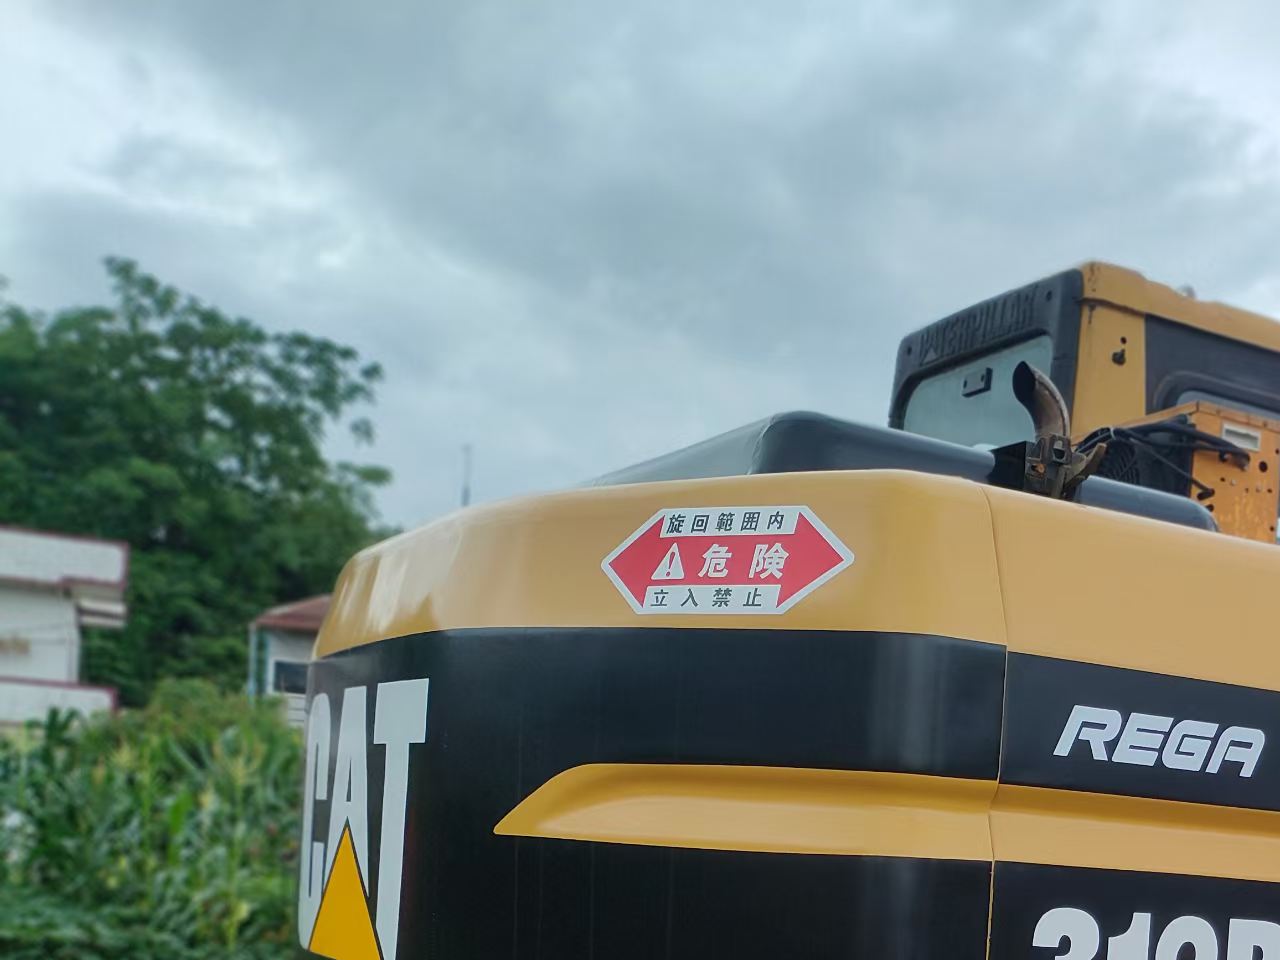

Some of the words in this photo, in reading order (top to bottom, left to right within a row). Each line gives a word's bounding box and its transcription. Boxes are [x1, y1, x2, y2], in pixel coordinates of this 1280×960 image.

[919, 286, 1038, 366] CATERPILLAR
[666, 511, 785, 534] 旋回範囲内
[697, 543, 789, 579] 危険
[650, 588, 762, 608] 立入禁止
[1053, 704, 1266, 778] REGA
